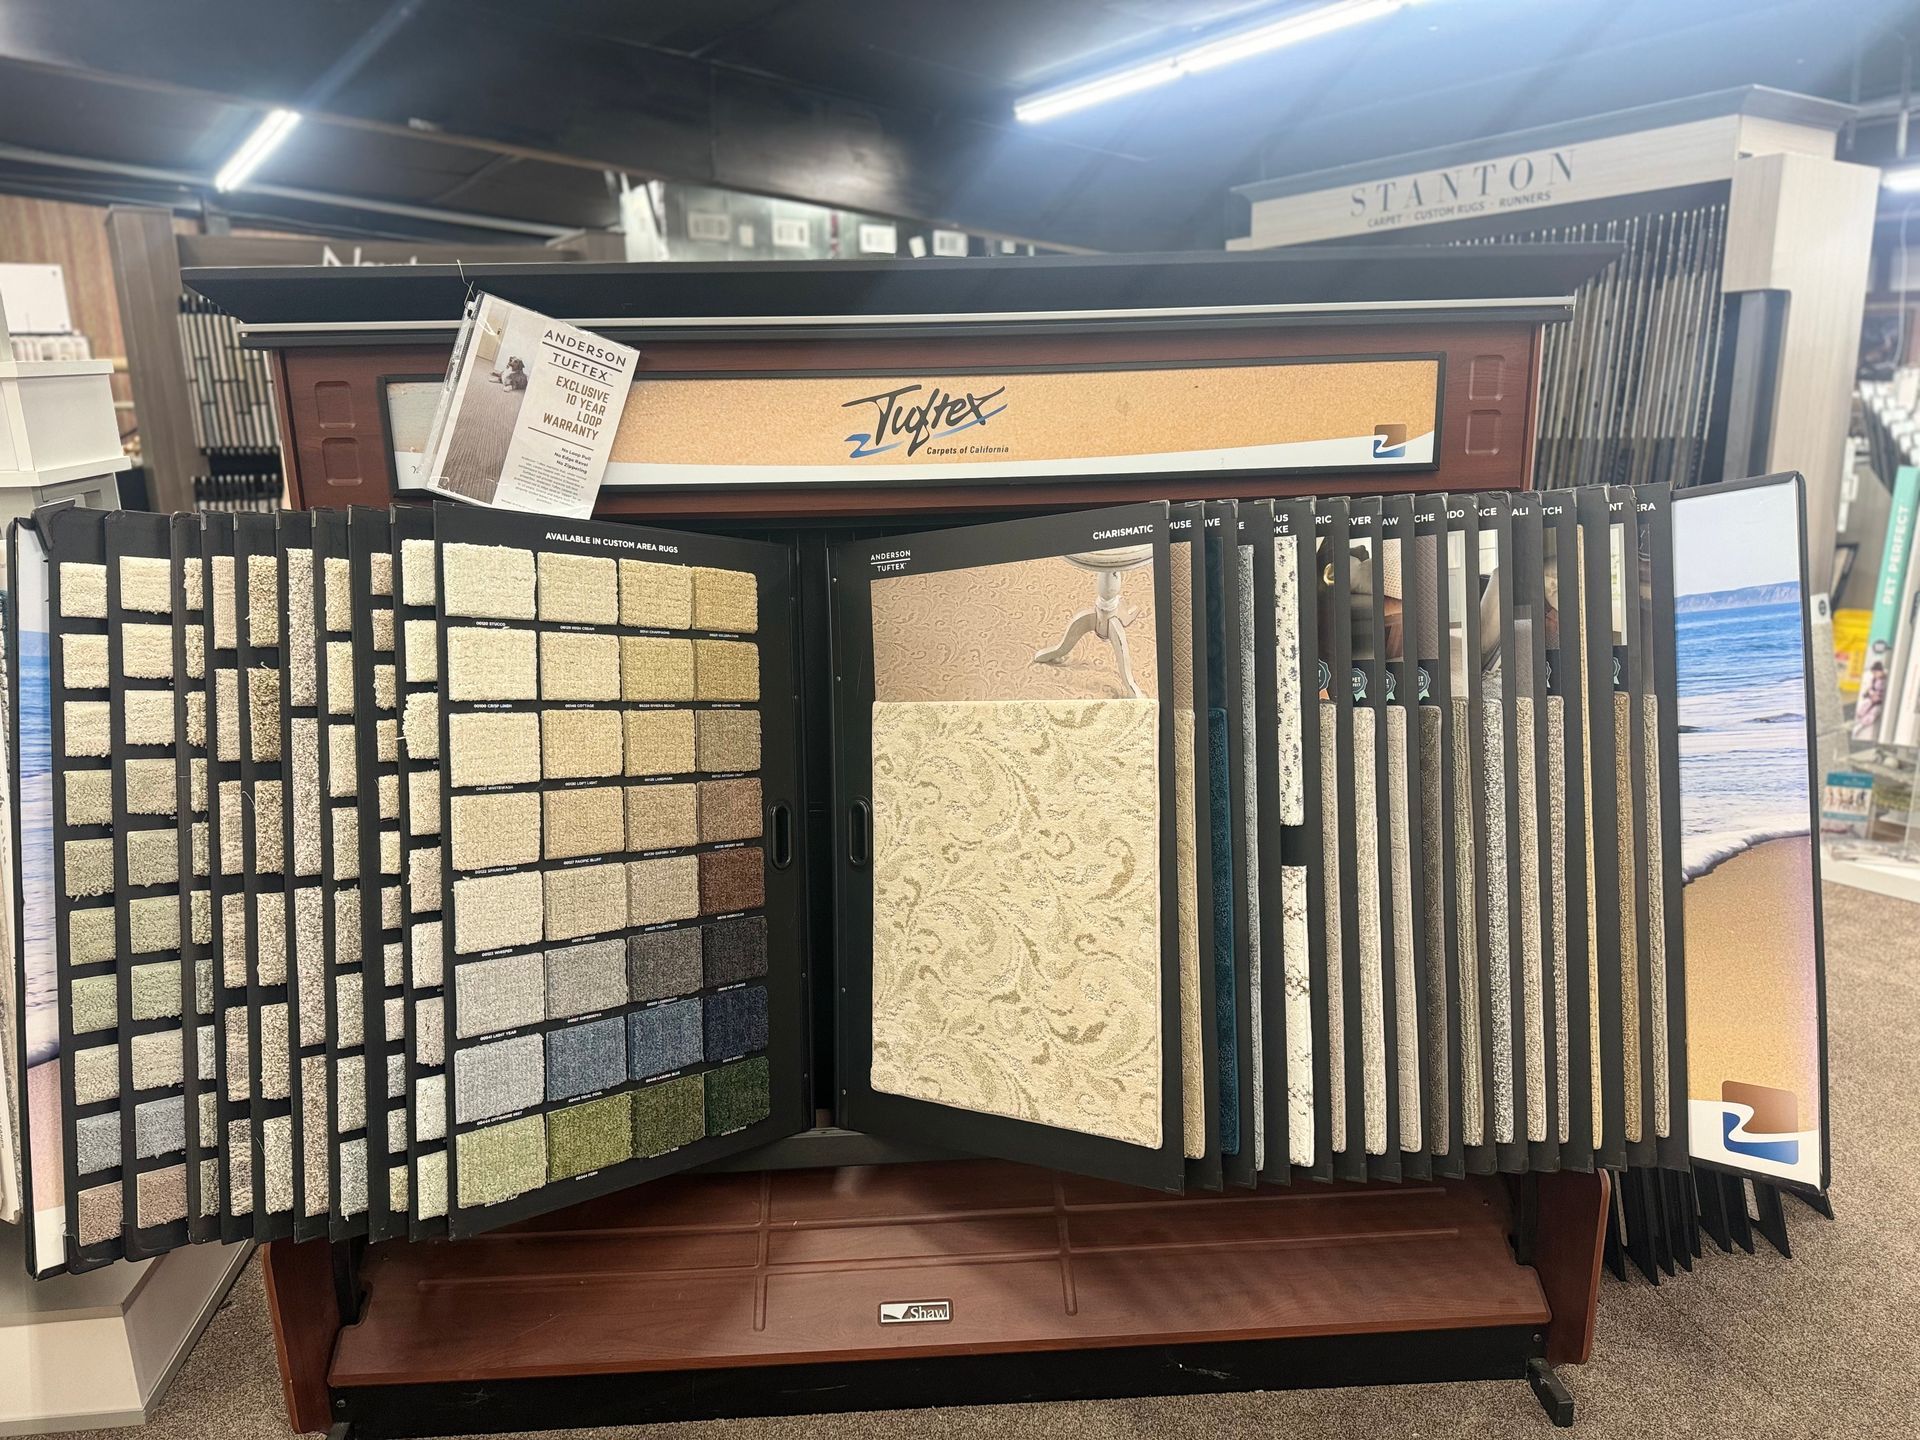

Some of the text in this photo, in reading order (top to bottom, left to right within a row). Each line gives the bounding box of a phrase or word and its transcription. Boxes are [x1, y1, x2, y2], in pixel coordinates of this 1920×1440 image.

[1351, 150, 1577, 217] STANTON
[1367, 191, 1552, 228] CARPET CUSTOM RUGS RUNNERS
[544, 330, 626, 367] ANDERSON
[556, 376, 610, 403] EXCLUSIVE
[566, 393, 606, 416] 10 YEAR
[543, 412, 599, 440] WARRANTY
[577, 411, 602, 428] LOOP
[841, 384, 1006, 457] Tuftex
[926, 446, 1010, 456] Carpets of California
[545, 532, 679, 554] AVAILABLE IN CUSTOM AREA RUGS
[1092, 524, 1154, 540] CHARISMATIC
[870, 550, 911, 561] ANDERSON
[1882, 504, 1909, 605] PET PERFECT
[910, 1306, 947, 1320] Shaw
